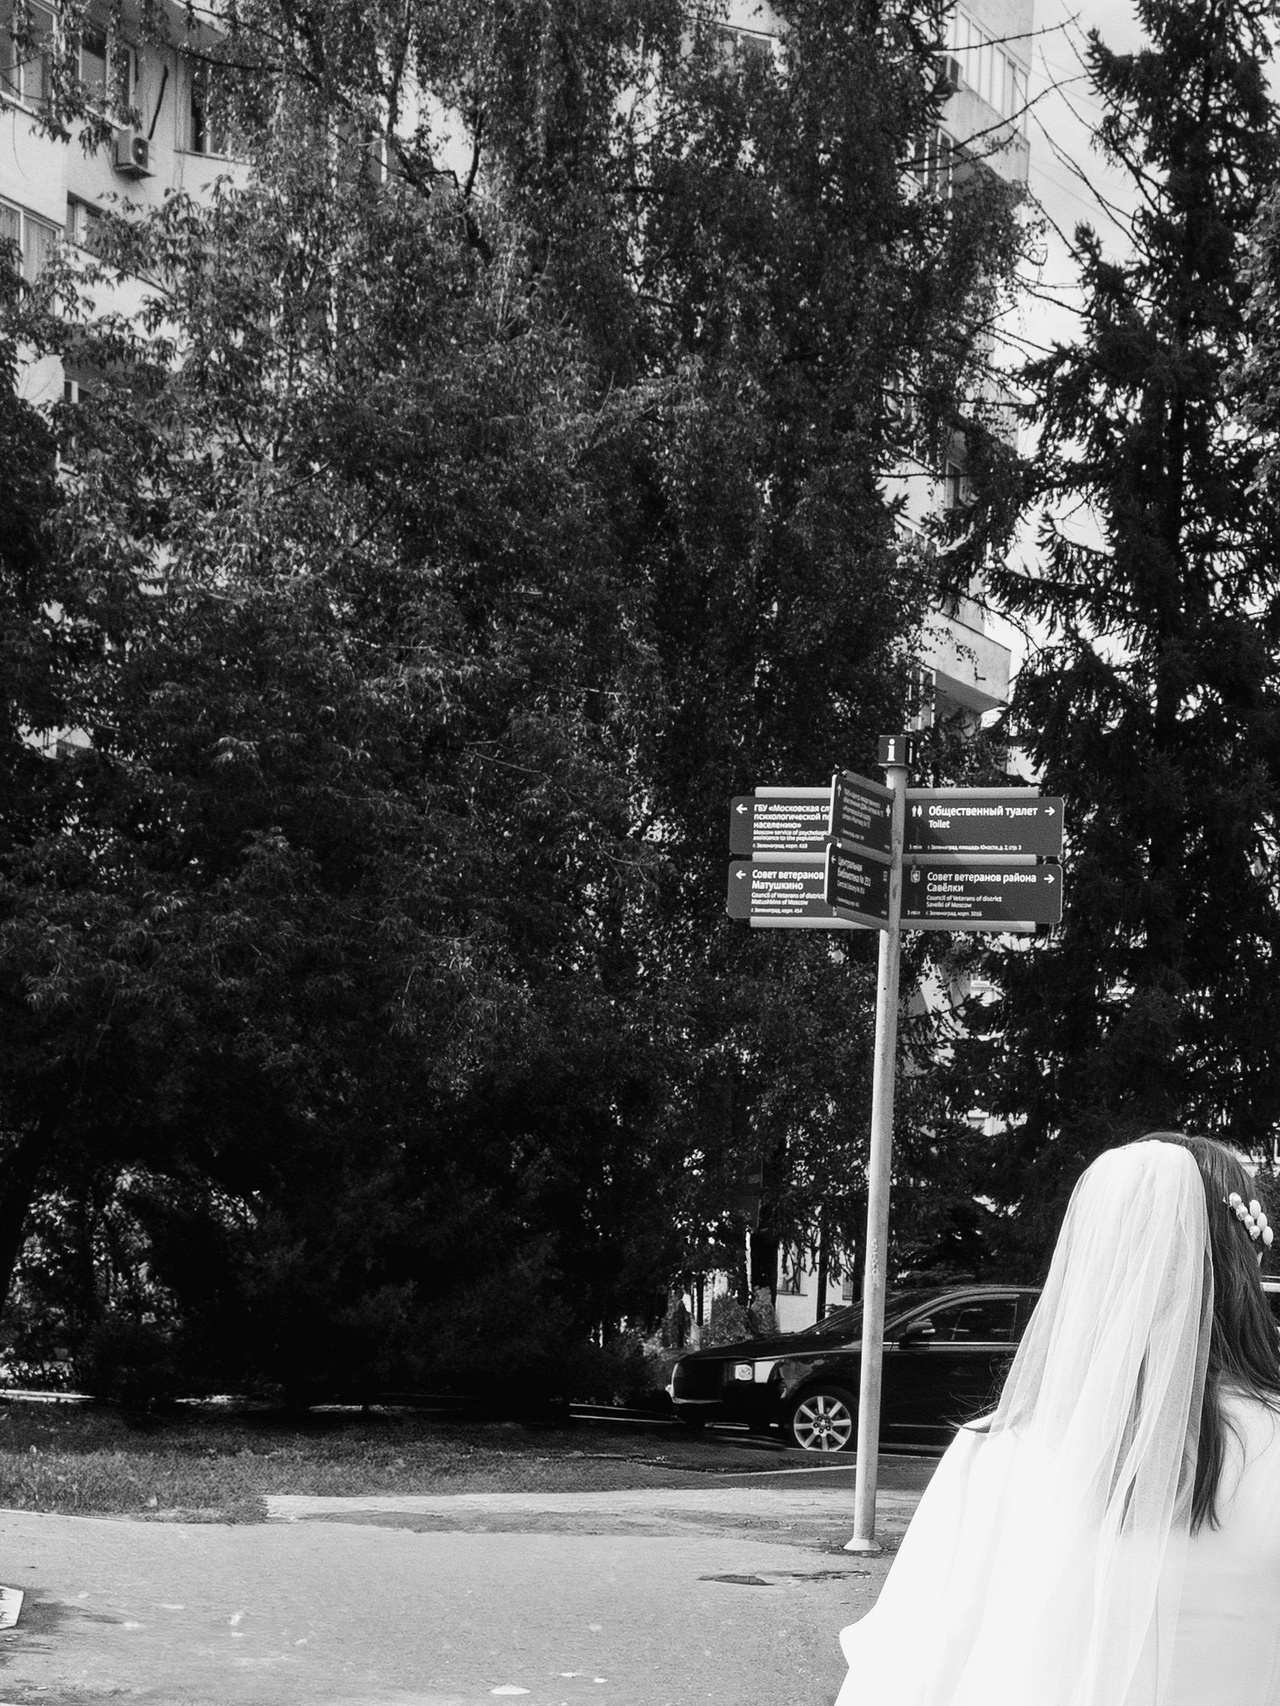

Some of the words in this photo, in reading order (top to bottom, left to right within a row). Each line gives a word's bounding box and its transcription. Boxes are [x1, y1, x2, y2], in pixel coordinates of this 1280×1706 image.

[754, 804, 768, 812] ГБУ
[768, 804, 820, 812] «Московская
[928, 805, 1004, 817] Общественный
[1005, 807, 1039, 818] туалет
[753, 812, 821, 820] психологической
[928, 820, 950, 828] Toilet
[752, 869, 777, 879] Совет
[778, 871, 825, 881] ветеранов
[927, 871, 953, 881] Совет
[954, 873, 1002, 884] ветеранов
[1002, 872, 1037, 884] района
[751, 880, 804, 892] Матушкино
[926, 882, 964, 892] Савёлки
